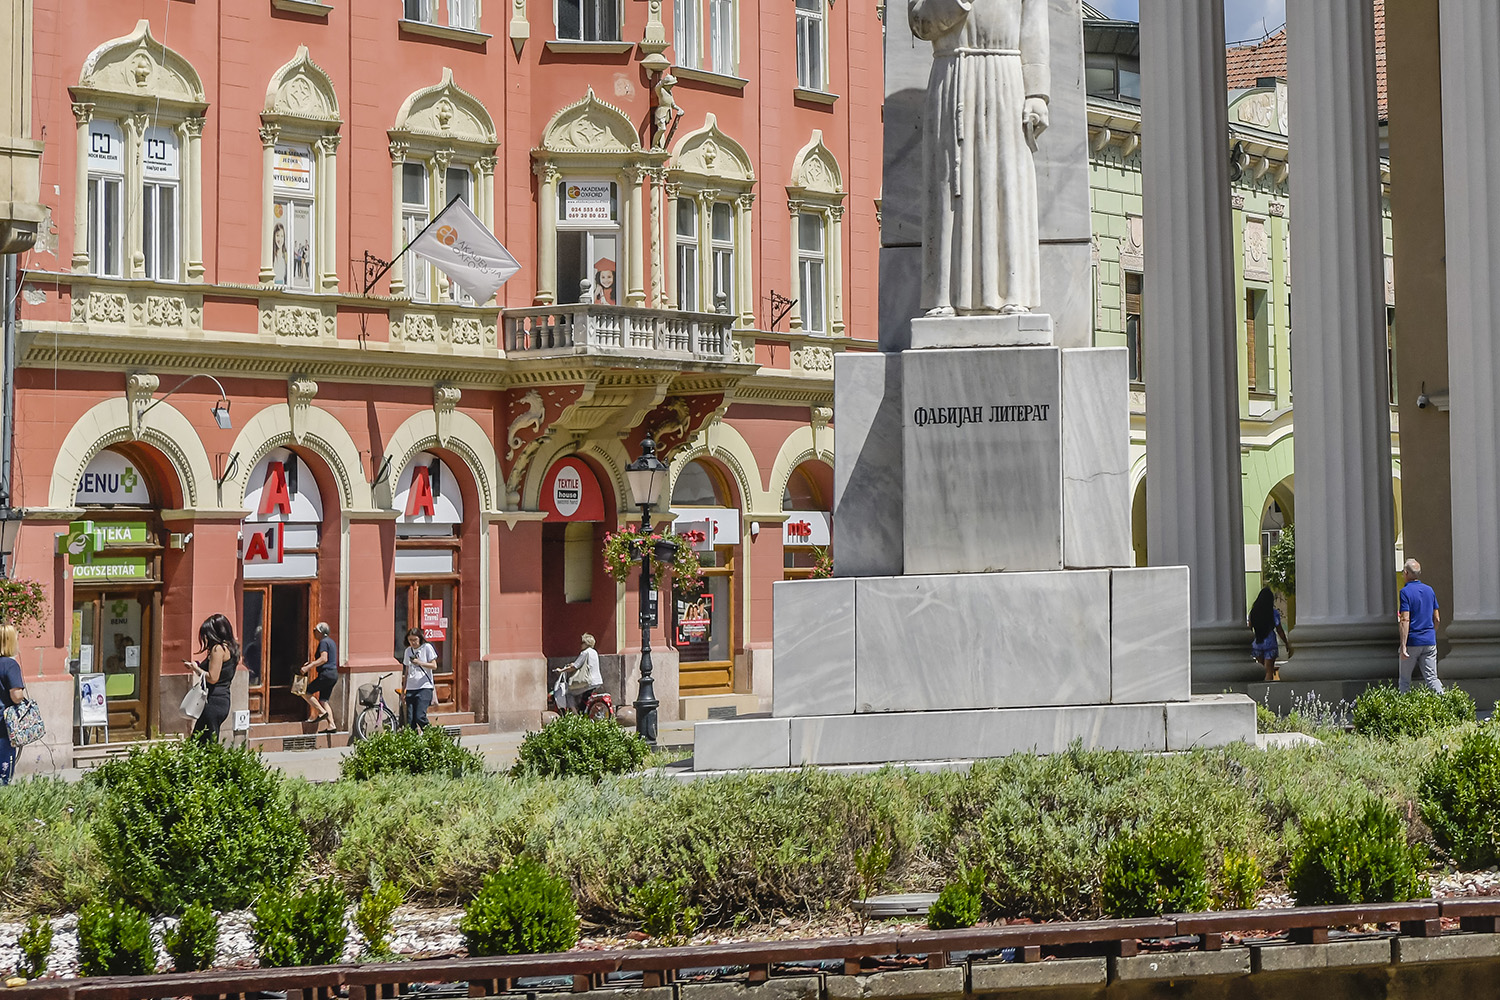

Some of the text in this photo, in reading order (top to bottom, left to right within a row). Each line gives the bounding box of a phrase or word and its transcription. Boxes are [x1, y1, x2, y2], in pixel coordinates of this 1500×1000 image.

[914, 404, 1050, 427] ФАБИЈАН ЛИТЕРАТ
[257, 453, 298, 514] A1
[404, 458, 441, 516] A1
[558, 478, 578, 488] TEXTILE
[788, 519, 812, 537] mts
[244, 527, 275, 560] A1
